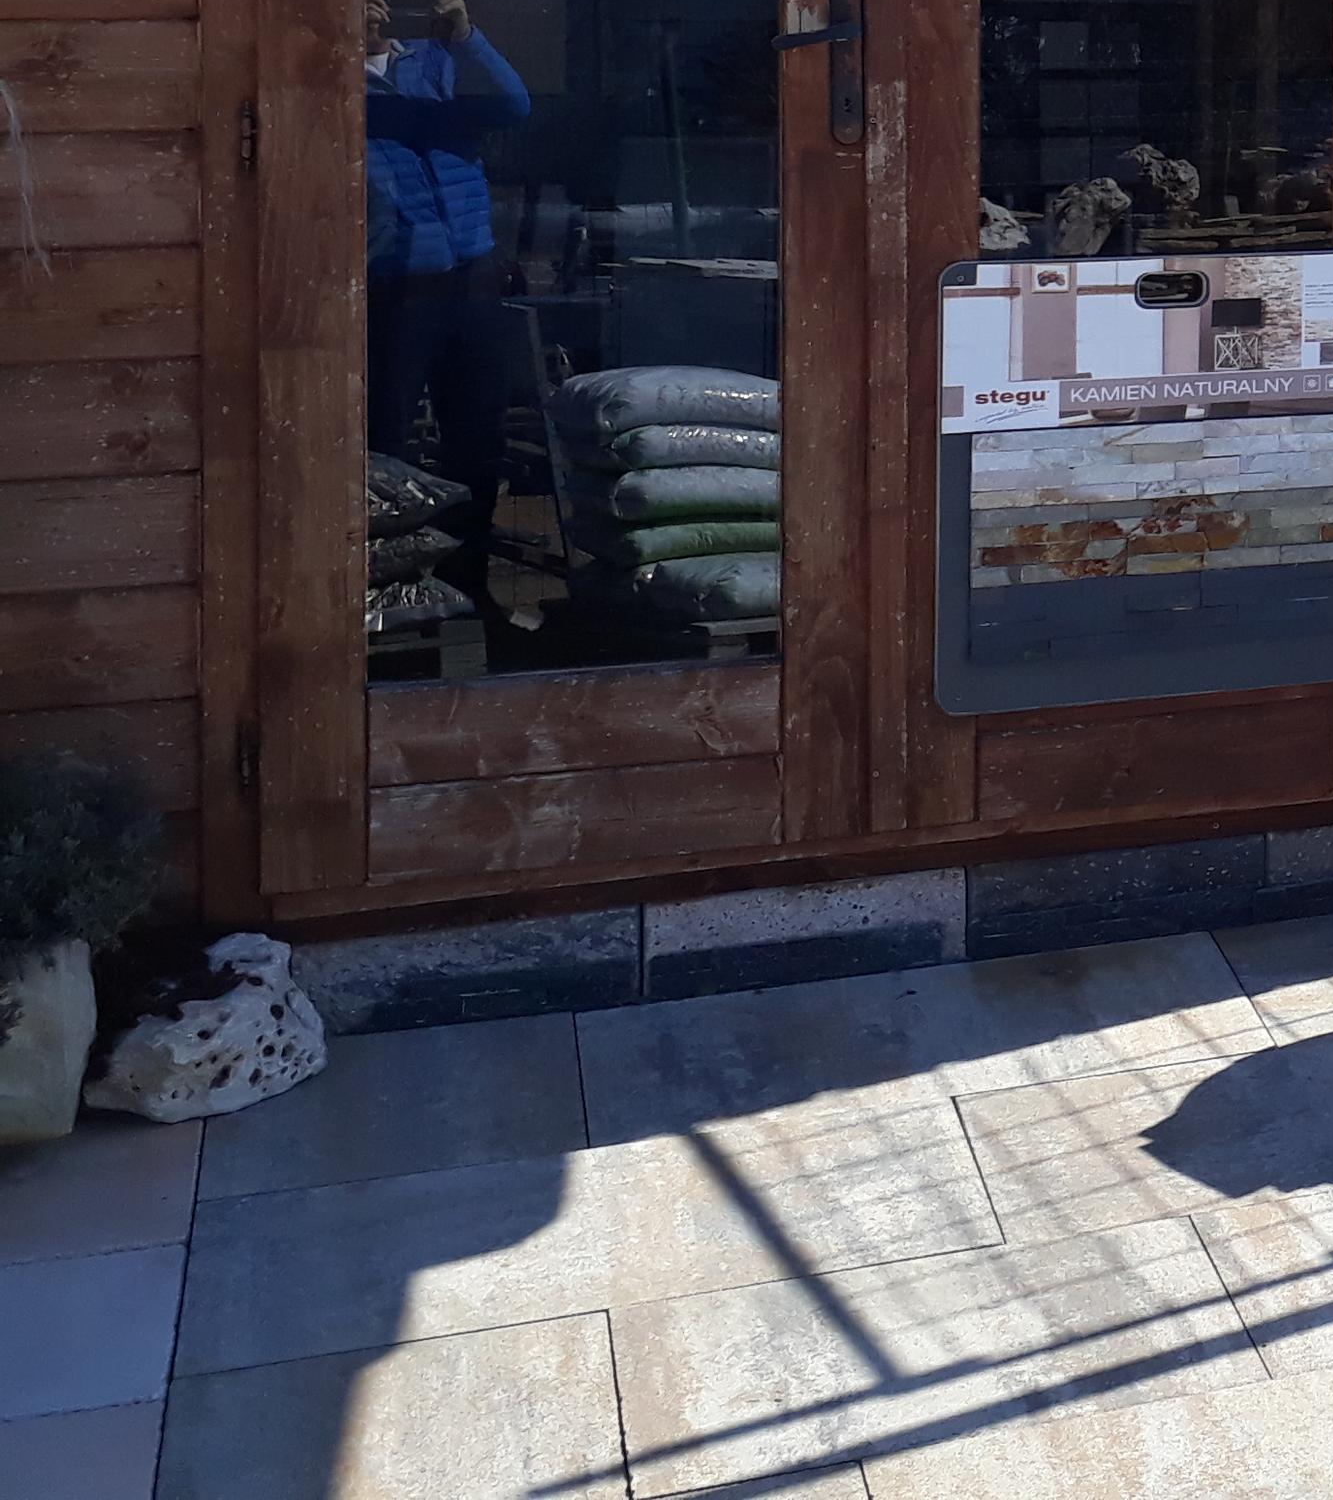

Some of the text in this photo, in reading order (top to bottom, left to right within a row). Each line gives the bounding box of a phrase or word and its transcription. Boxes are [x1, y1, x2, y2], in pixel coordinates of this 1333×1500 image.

[975, 390, 1046, 405] stegu
[1071, 377, 1294, 402] KAMIEŃ NATURALNY
